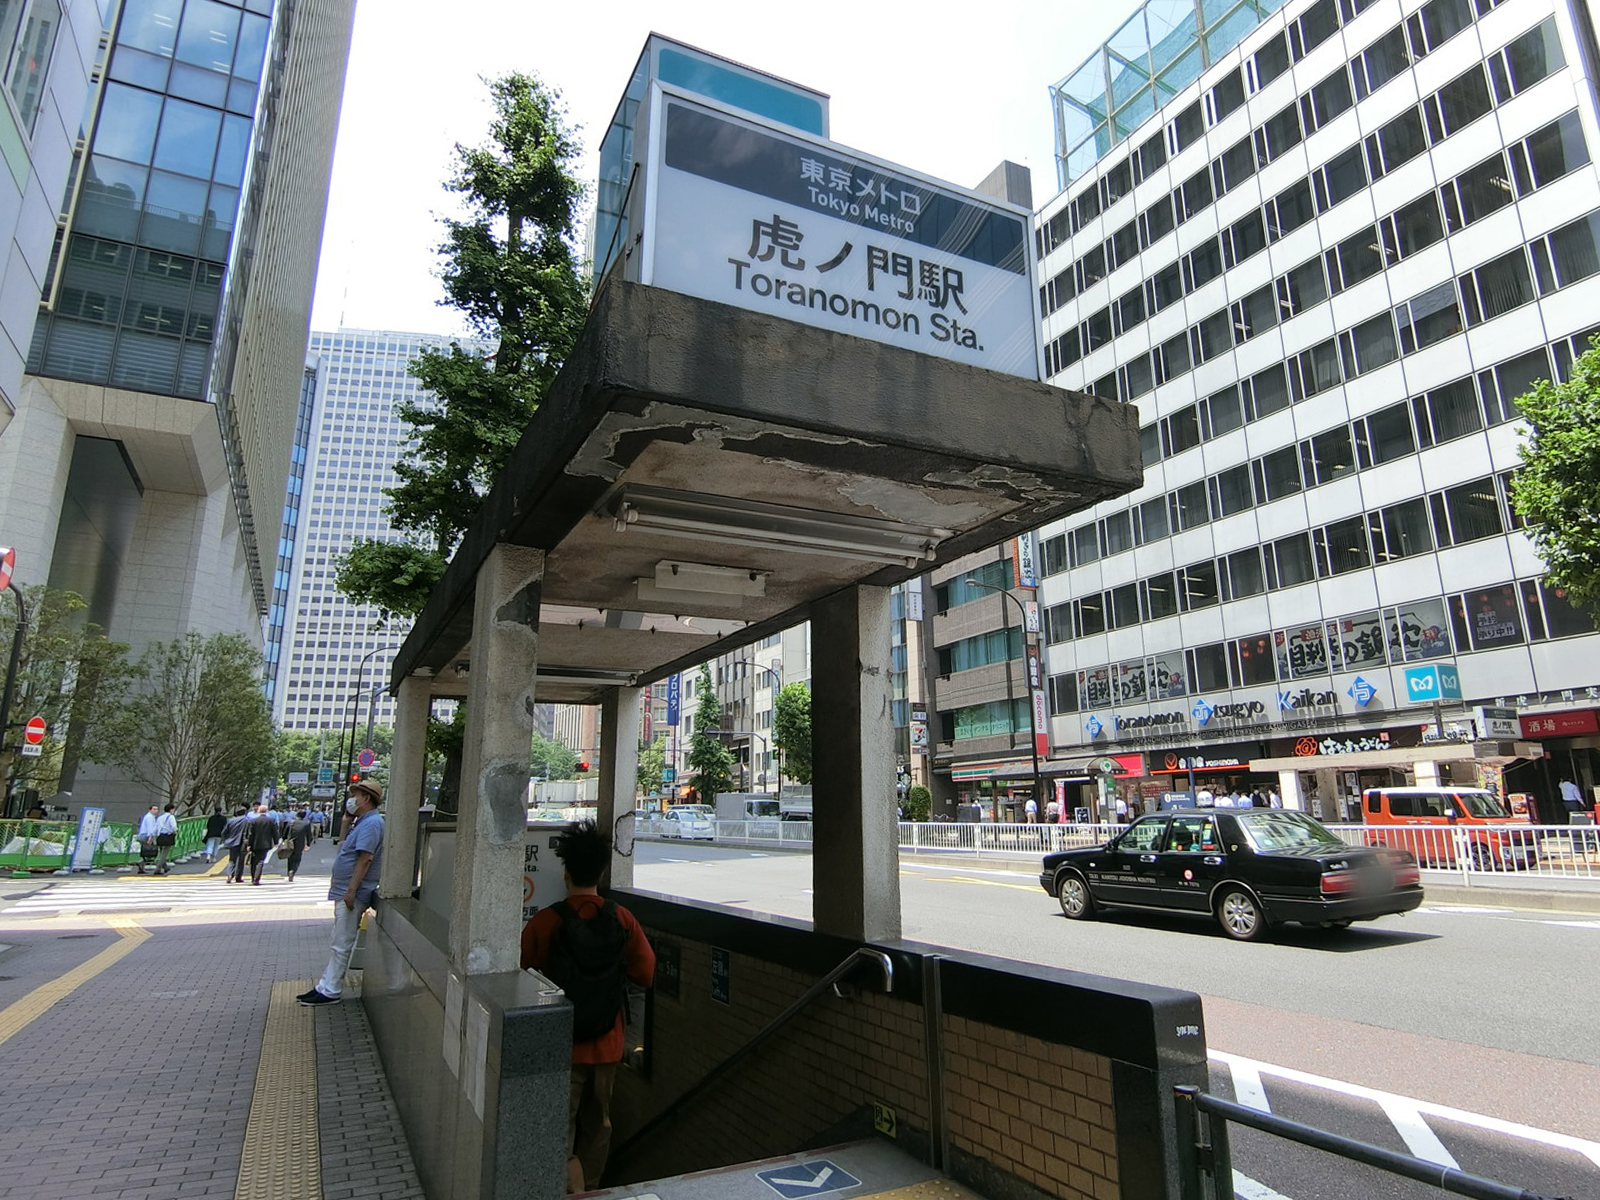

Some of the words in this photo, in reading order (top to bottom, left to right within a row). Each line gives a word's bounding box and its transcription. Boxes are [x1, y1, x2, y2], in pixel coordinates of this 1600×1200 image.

[800, 157, 921, 215] 東京メトロ
[808, 186, 859, 216] Tokyo
[864, 206, 915, 233] Metro
[747, 215, 968, 315] 虎ノ門駅
[728, 258, 920, 335] Toranomon
[930, 314, 984, 352] Sta.
[1112, 710, 1184, 731] Toranomon
[1276, 688, 1338, 710] Kaikan
[1528, 719, 1556, 732] 酒場
